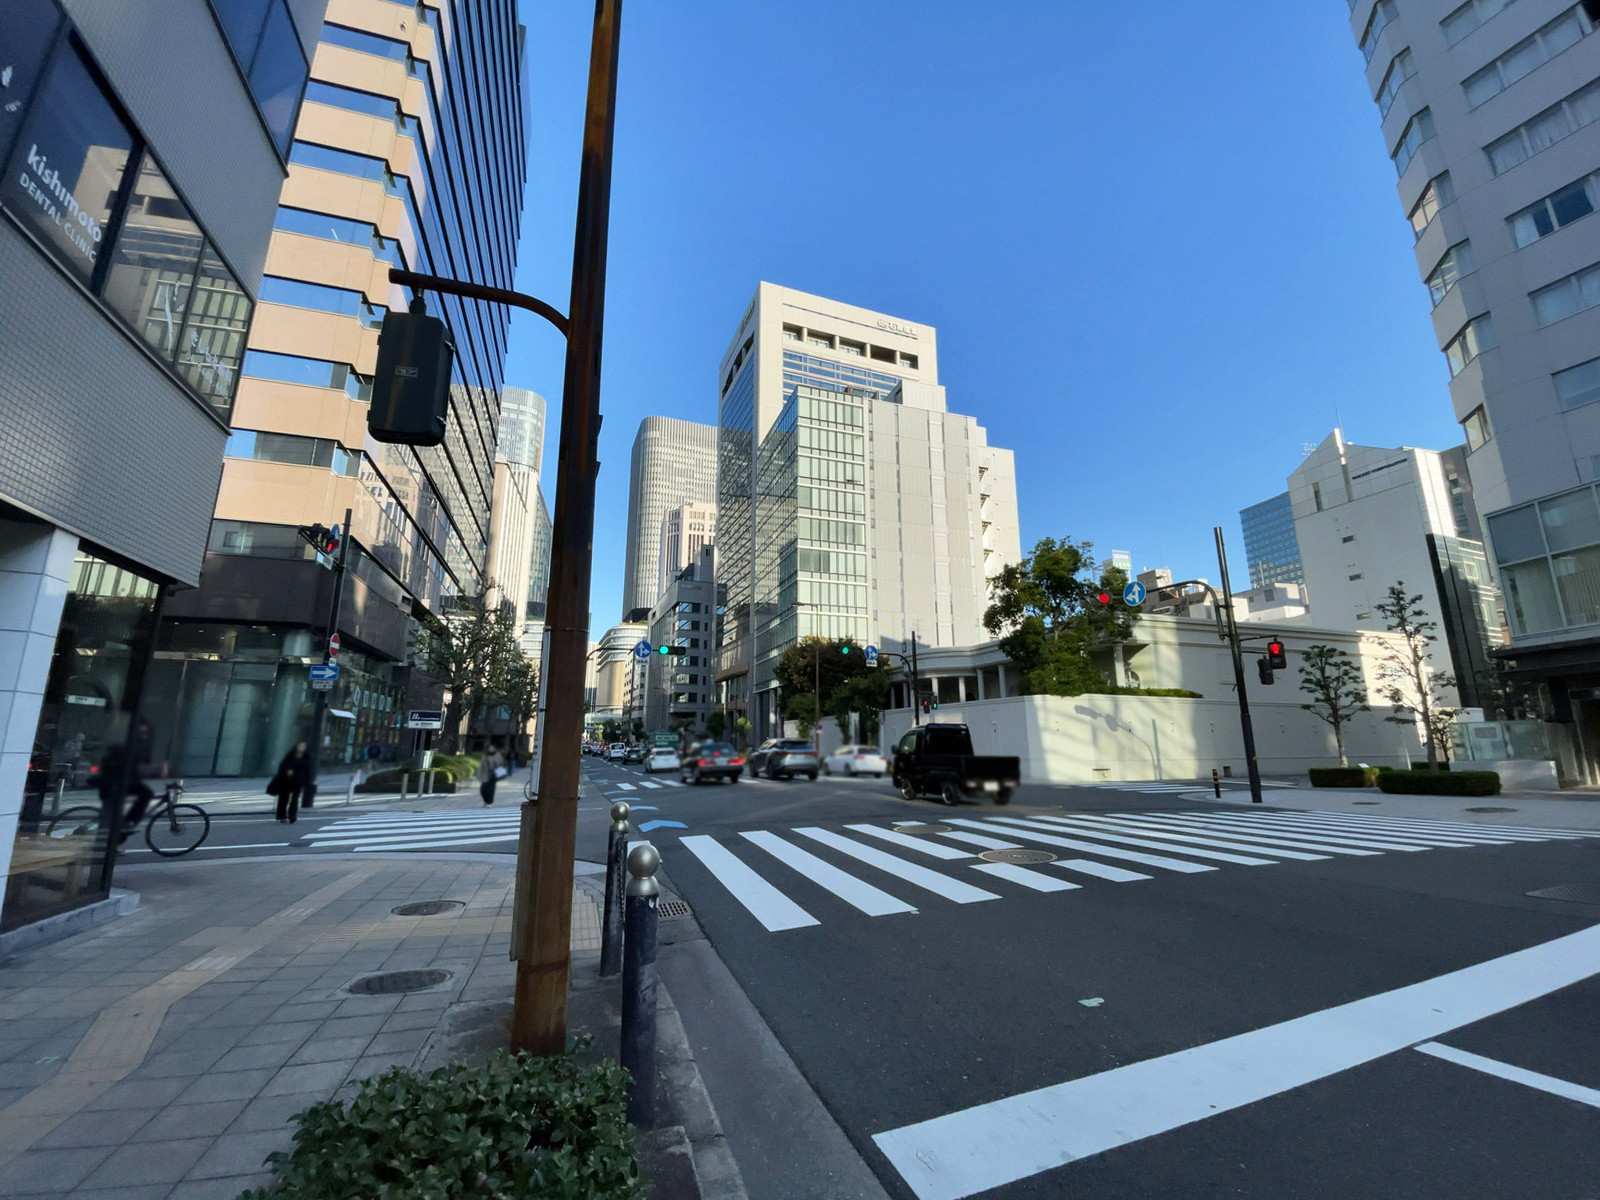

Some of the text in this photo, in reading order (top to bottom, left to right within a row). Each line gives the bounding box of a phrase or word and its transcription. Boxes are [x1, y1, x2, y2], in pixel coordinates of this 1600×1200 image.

[20, 172, 97, 263] DENTAL CLINIC
[27, 144, 102, 242] kishimoto
